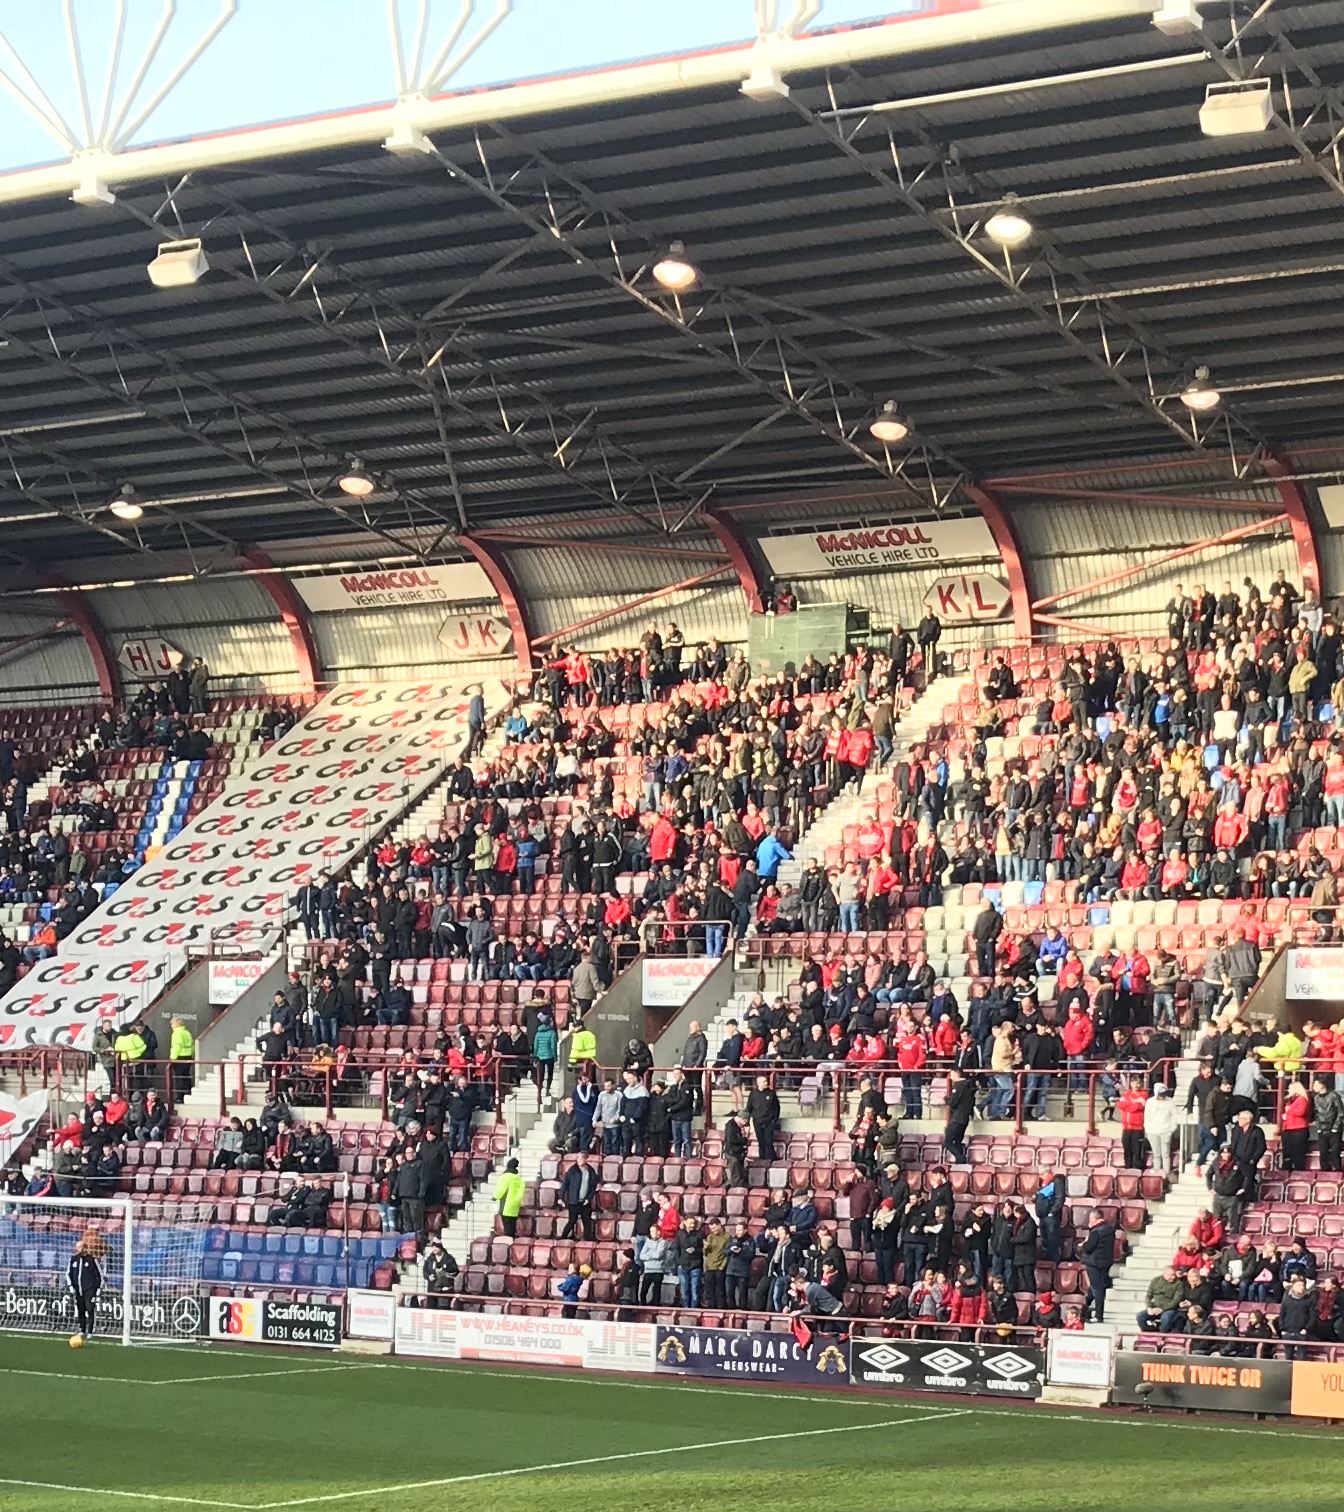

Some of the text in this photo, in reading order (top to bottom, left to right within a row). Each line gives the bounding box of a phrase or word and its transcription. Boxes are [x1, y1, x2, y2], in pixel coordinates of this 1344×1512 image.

[825, 546, 940, 568] VEHICLE HIRE LTD
[351, 587, 447, 606] VEHICLE HIRE LTD
[936, 580, 998, 614] K L
[453, 619, 499, 650] J K
[129, 643, 172, 673] H J
[51, 1294, 70, 1316] of
[267, 1303, 336, 1326] Scaffolding
[267, 1325, 336, 1342] 0131 664 4125
[484, 1334, 515, 1347] 01506
[517, 1336, 538, 1348] 464
[689, 1336, 814, 1361] MARC DARCY
[863, 1371, 1029, 1392] umbro umbro umbro
[1142, 1363, 1262, 1388] THINK TWICE OR
